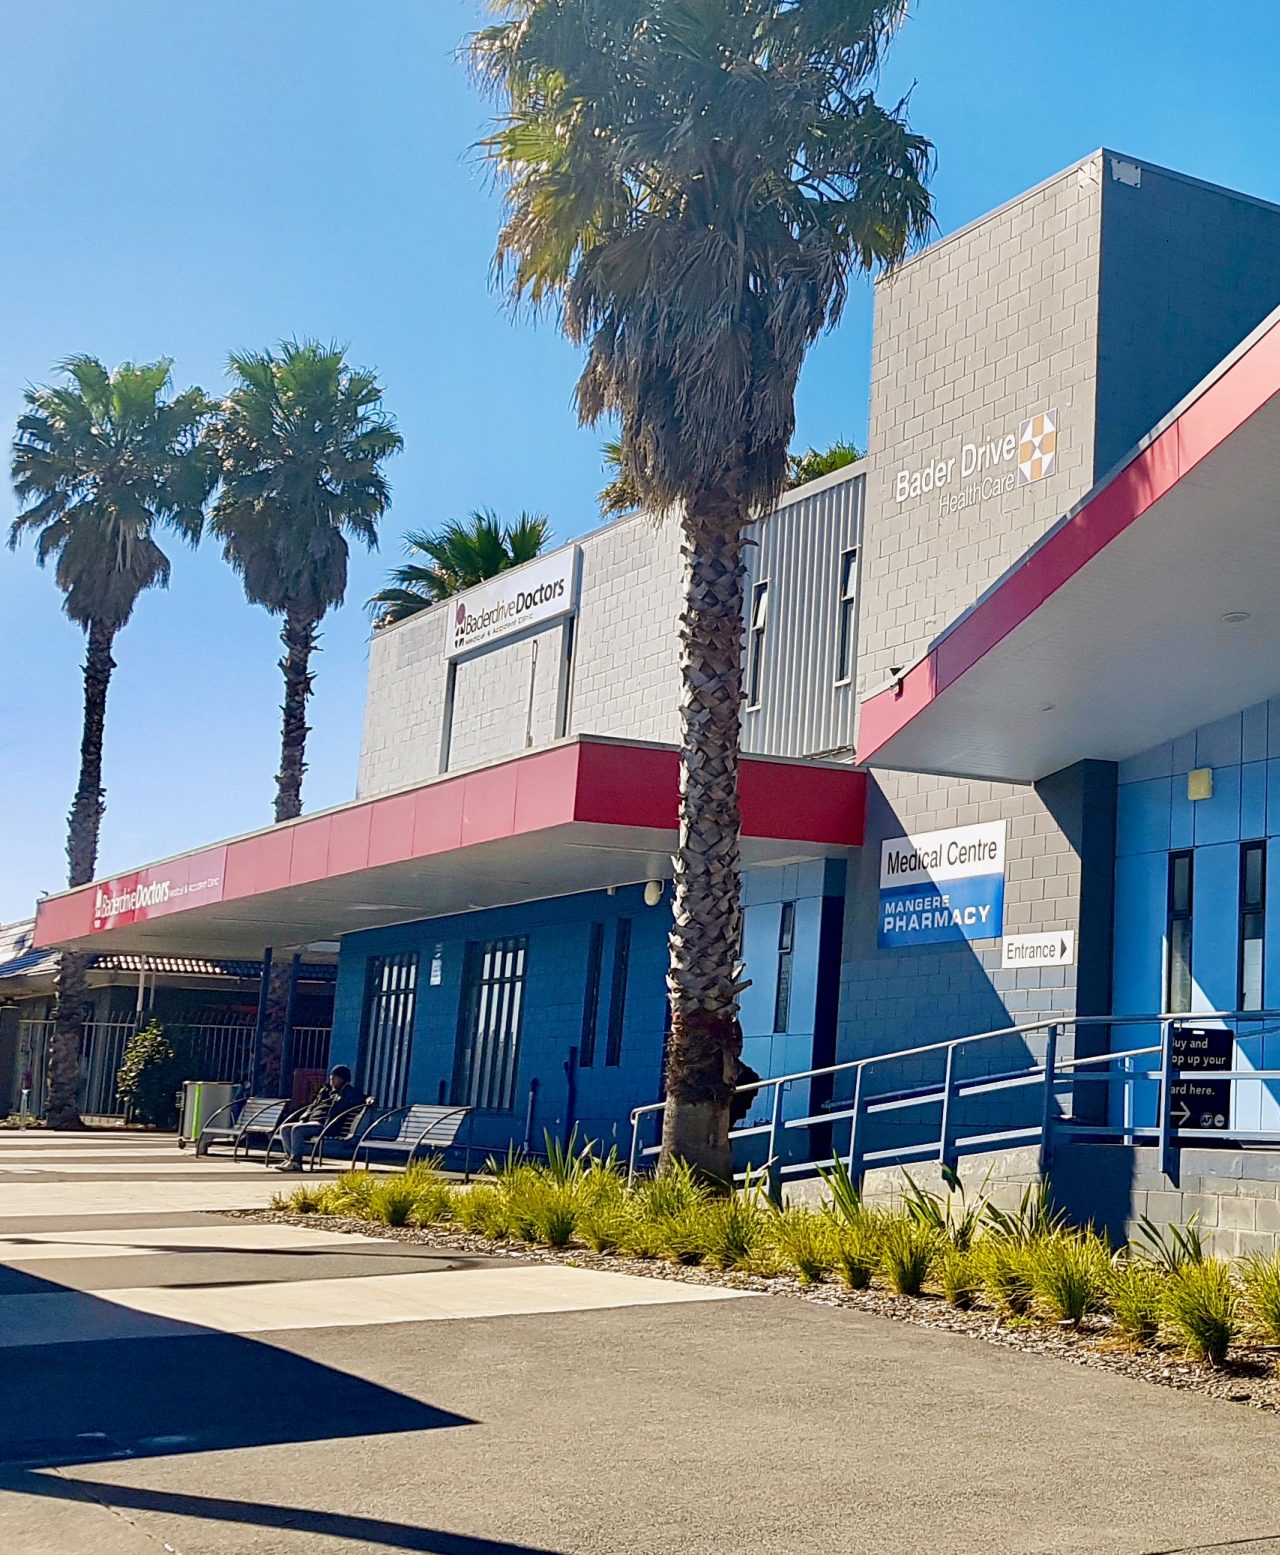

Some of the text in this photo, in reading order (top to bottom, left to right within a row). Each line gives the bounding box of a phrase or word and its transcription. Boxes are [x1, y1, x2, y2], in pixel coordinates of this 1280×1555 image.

[896, 434, 1017, 503] Bader Drive
[938, 473, 1015, 517] HealthCare
[887, 839, 998, 876] Medical Centre
[885, 895, 950, 915] MANGERE
[883, 904, 991, 934] PHARMACY
[1007, 942, 1056, 960] Entrance
[1173, 1037, 1208, 1051] uy and
[1171, 1055, 1226, 1067] op up your
[1170, 1083, 1215, 1095] ard here.
